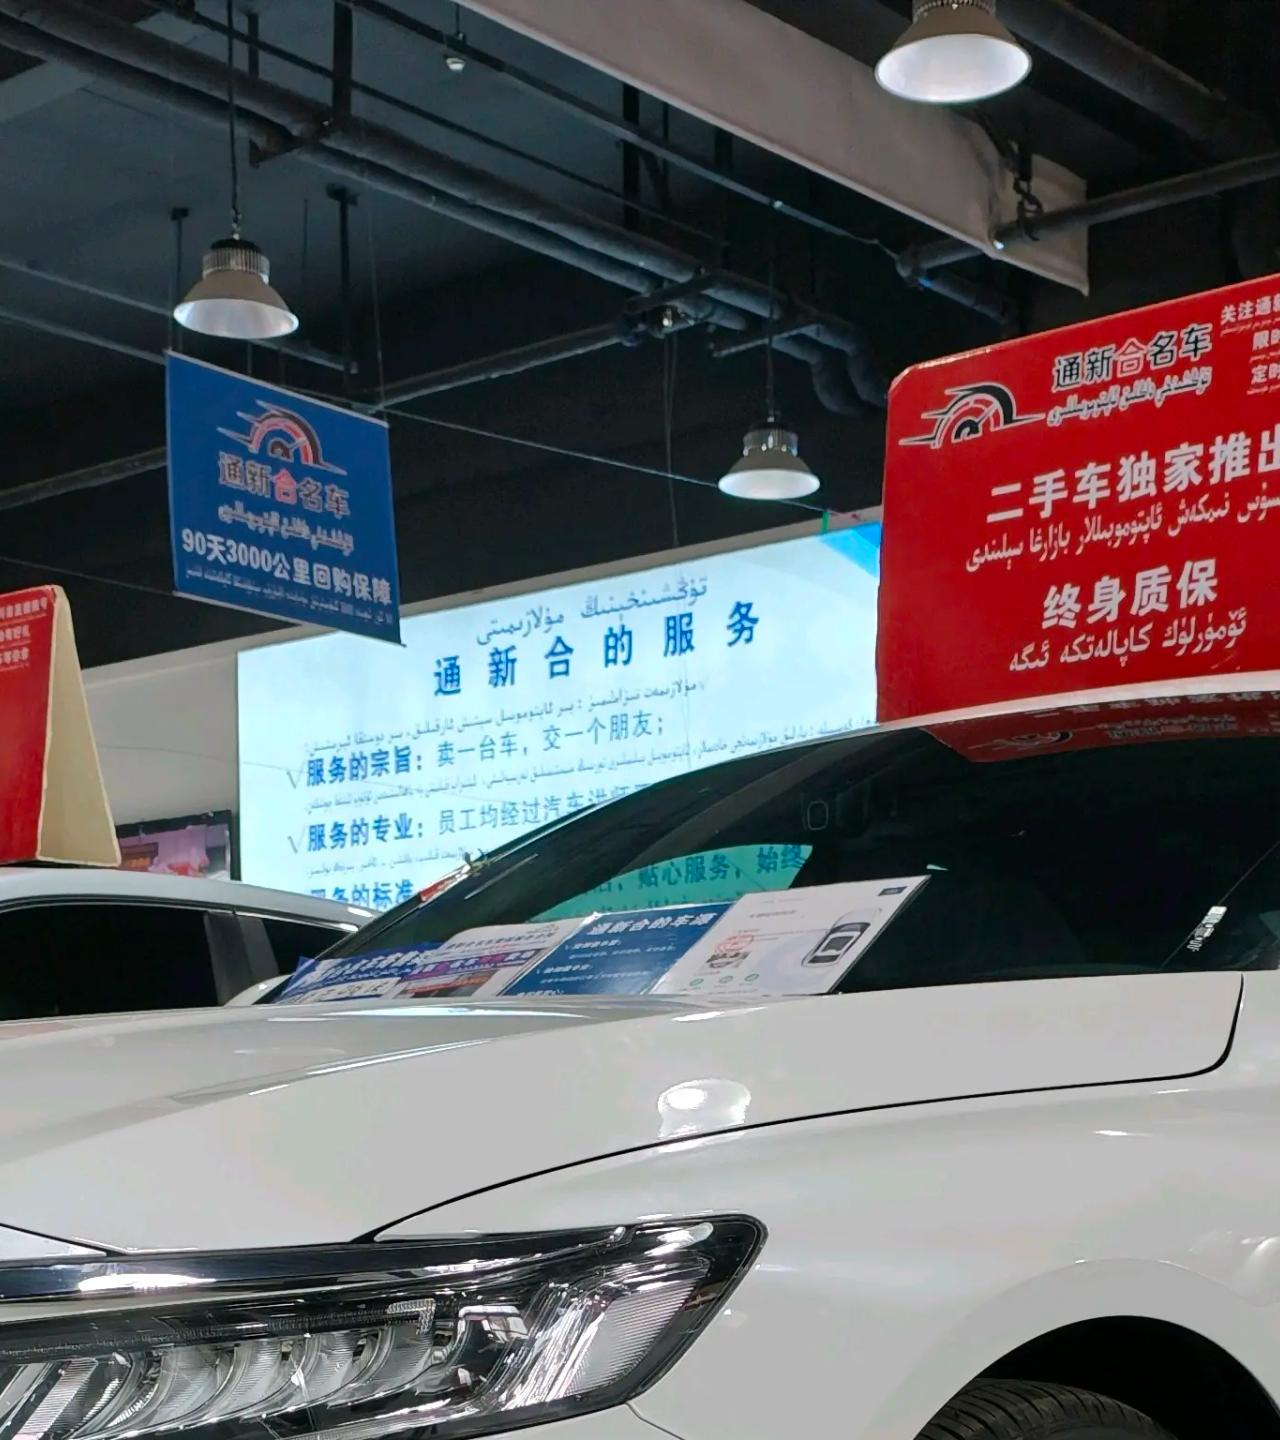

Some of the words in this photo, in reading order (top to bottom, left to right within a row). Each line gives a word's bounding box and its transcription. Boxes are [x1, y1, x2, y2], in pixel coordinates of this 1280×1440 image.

[1052, 324, 1212, 392] 通新合名车
[218, 451, 351, 520] 通新合名车
[181, 528, 392, 605] 90天3000公里回购保障
[1041, 557, 1218, 629] 终身质保
[434, 600, 759, 698] 通新合的服务
